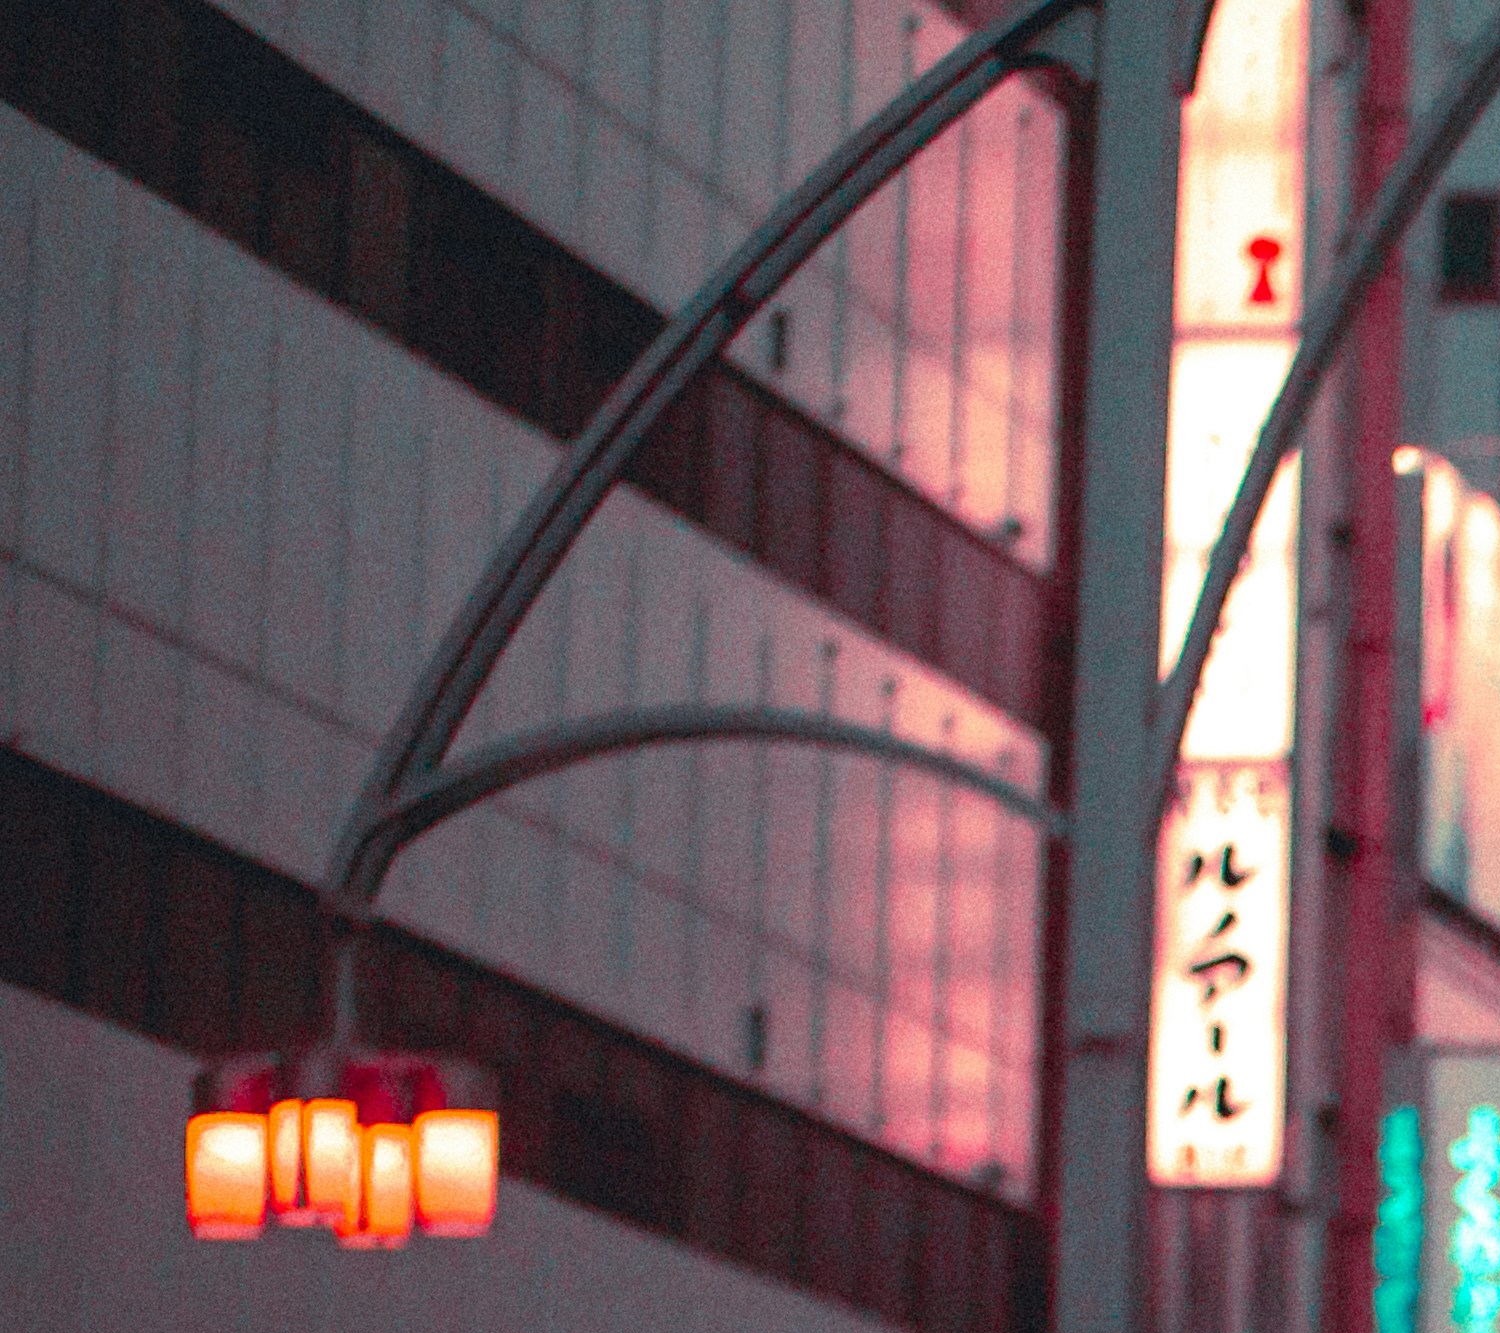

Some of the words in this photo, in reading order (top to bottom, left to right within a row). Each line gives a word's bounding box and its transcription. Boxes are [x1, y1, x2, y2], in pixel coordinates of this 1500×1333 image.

[1180, 844, 1254, 1120] ルノアール
